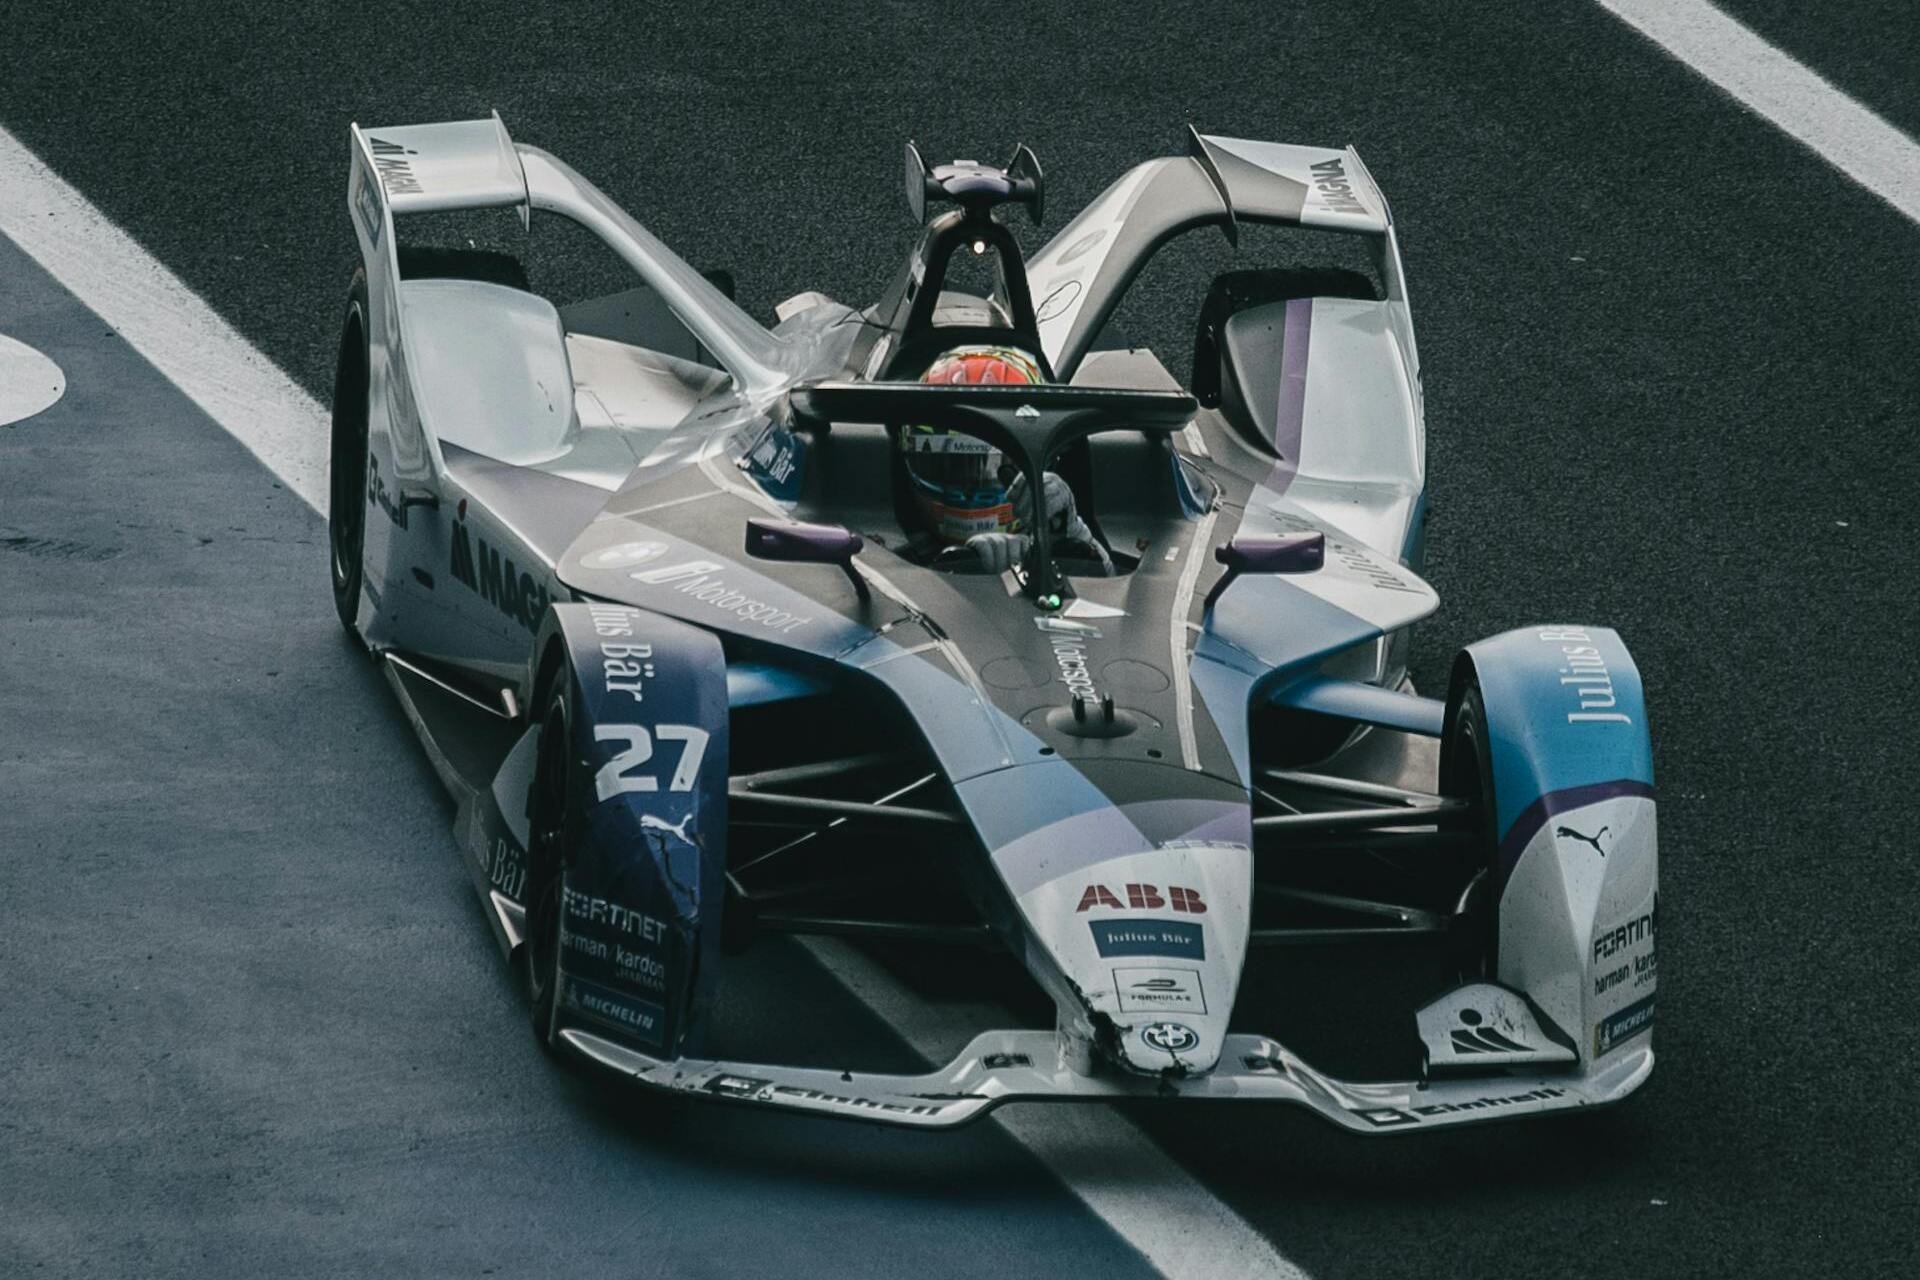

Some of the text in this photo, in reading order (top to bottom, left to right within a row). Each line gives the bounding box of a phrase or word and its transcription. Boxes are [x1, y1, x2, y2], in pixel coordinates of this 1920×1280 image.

[674, 575, 813, 633] Motorsport
[600, 642, 655, 702] Bär
[1559, 646, 1632, 724] Julius
[593, 723, 711, 803] 27
[1076, 883, 1208, 915] ABB
[1107, 932, 1193, 945] Julius Bär
[582, 993, 655, 1030] MICHELIN
